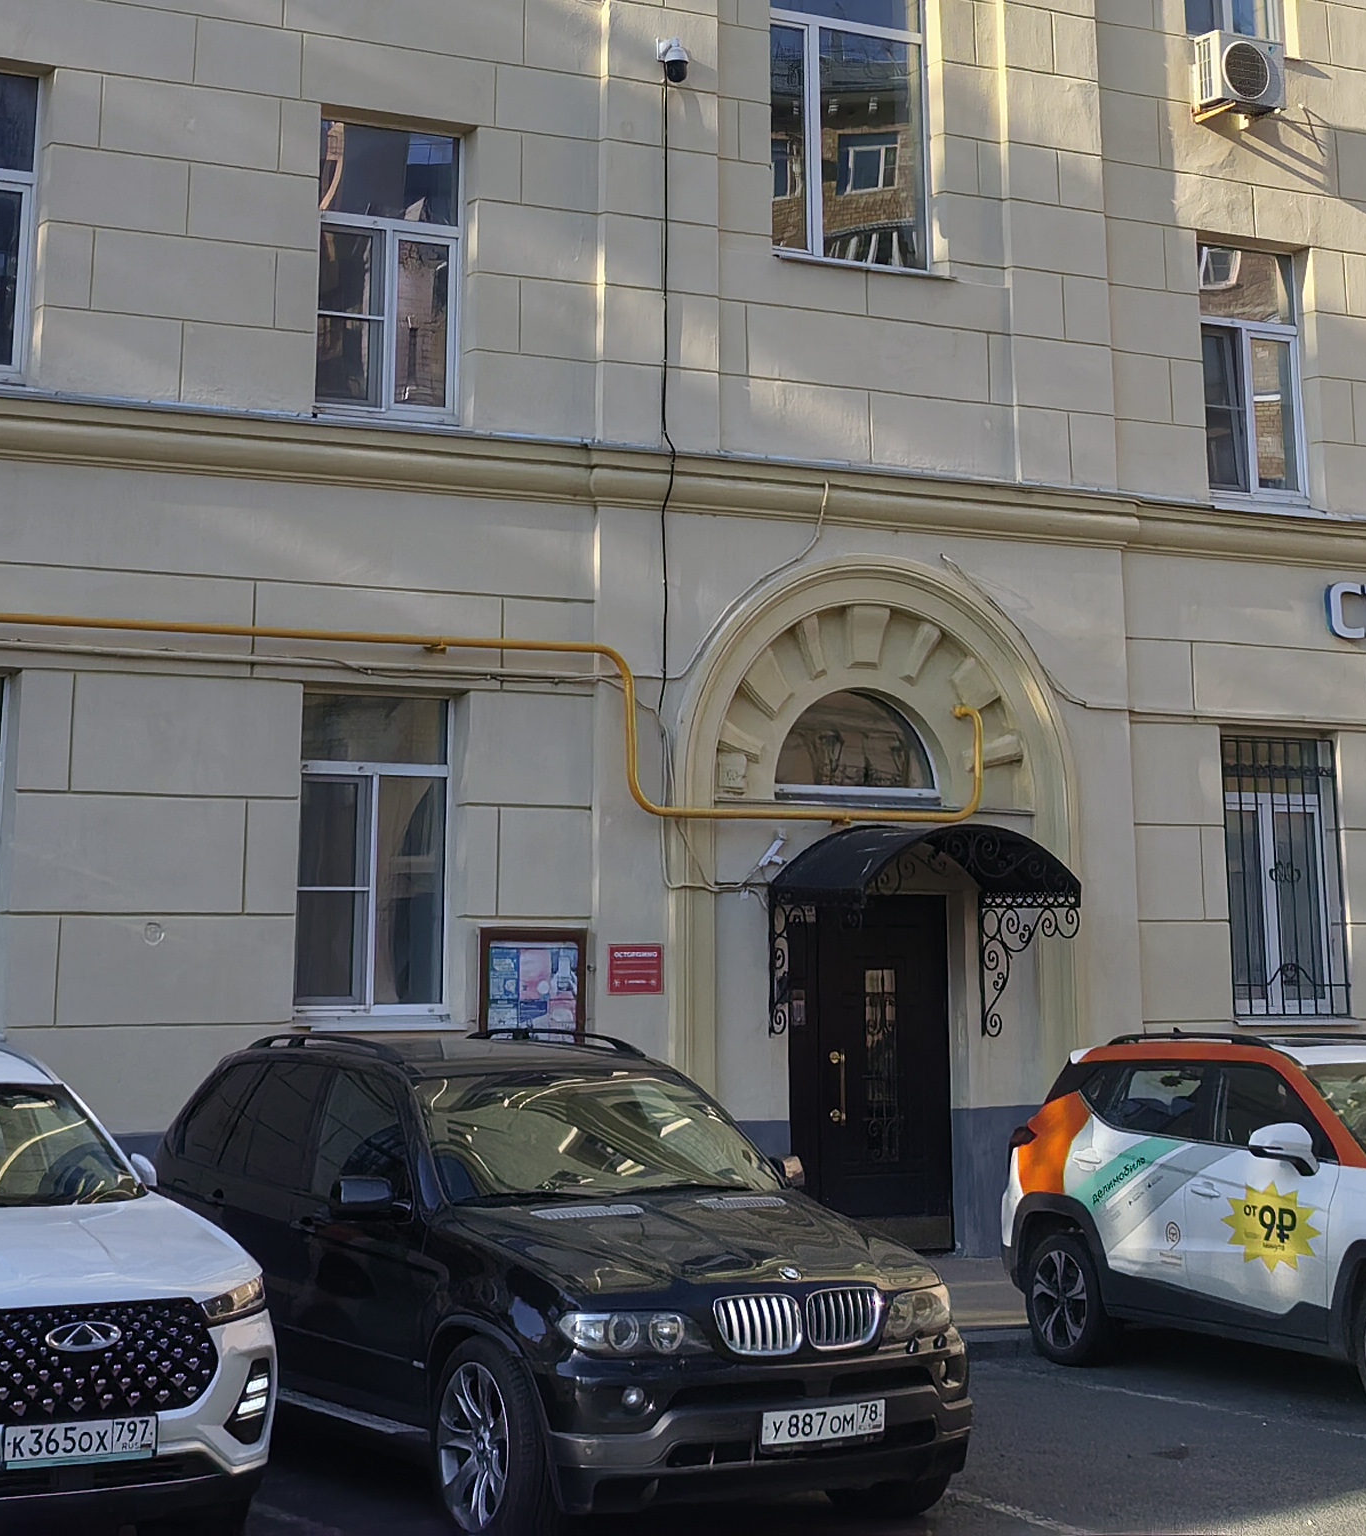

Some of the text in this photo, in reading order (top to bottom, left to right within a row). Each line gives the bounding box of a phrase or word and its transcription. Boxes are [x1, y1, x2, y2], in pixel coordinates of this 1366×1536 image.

[12, 1419, 151, 1458] К365ОХ 797
[773, 1403, 878, 1440] У887ОМ 78
